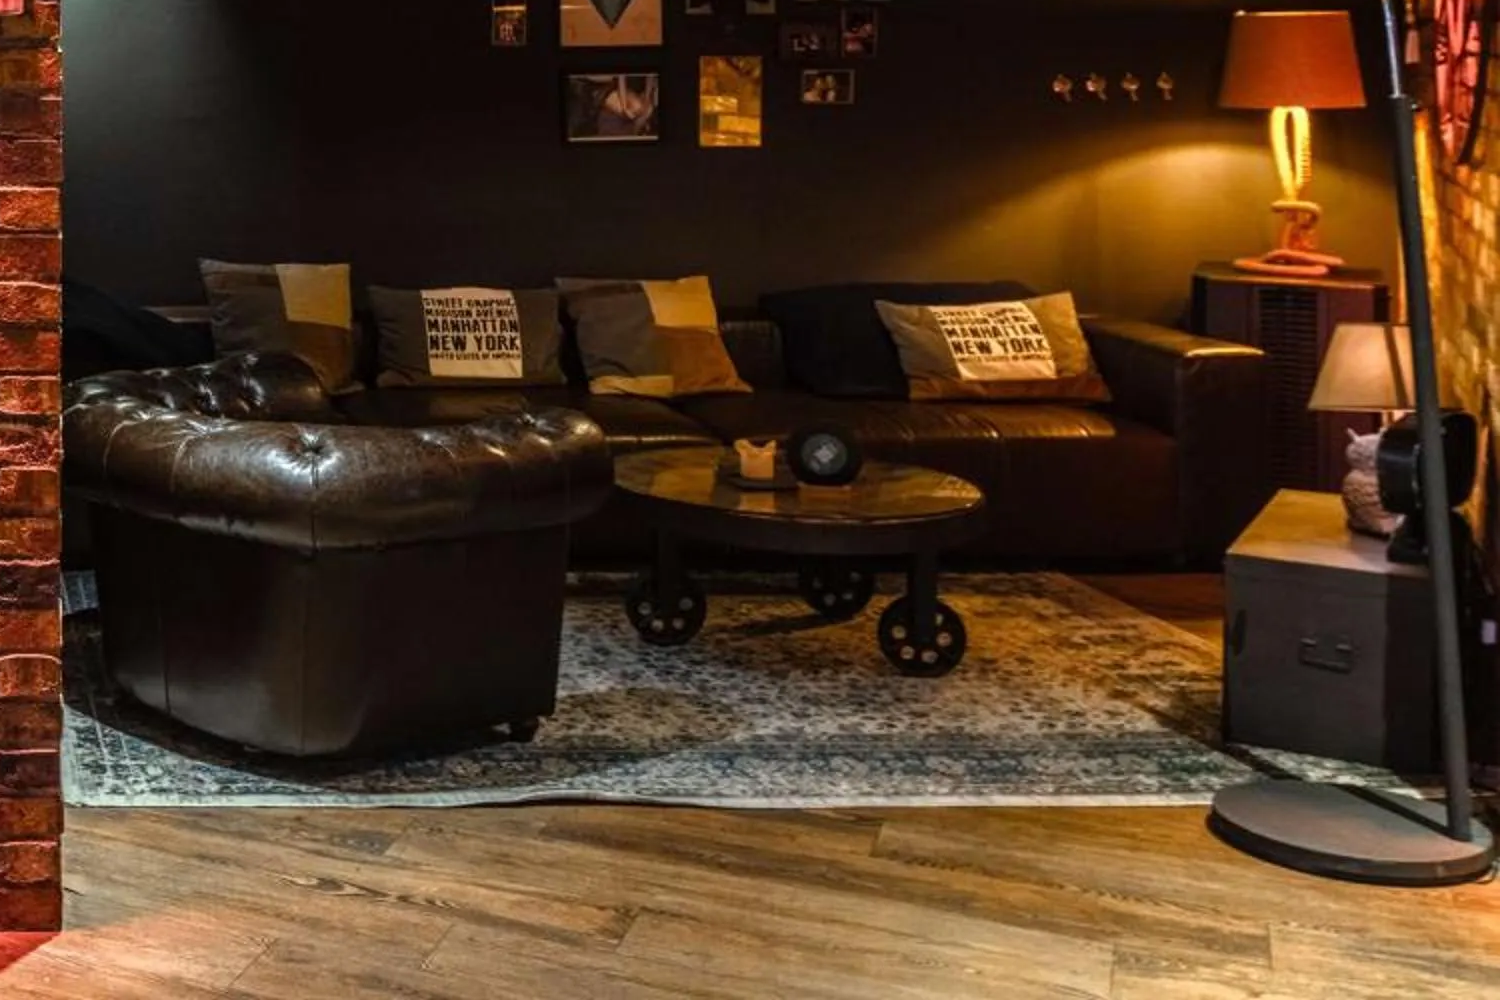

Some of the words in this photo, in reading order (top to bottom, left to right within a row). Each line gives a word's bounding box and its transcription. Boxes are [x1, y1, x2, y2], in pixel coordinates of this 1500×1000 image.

[427, 318, 519, 333] MANHATTAN
[944, 324, 1041, 338] MANHATTAN
[429, 335, 467, 351] NEW
[472, 335, 520, 351] YORK
[951, 339, 992, 355] NEW
[996, 337, 1048, 353] YORK
